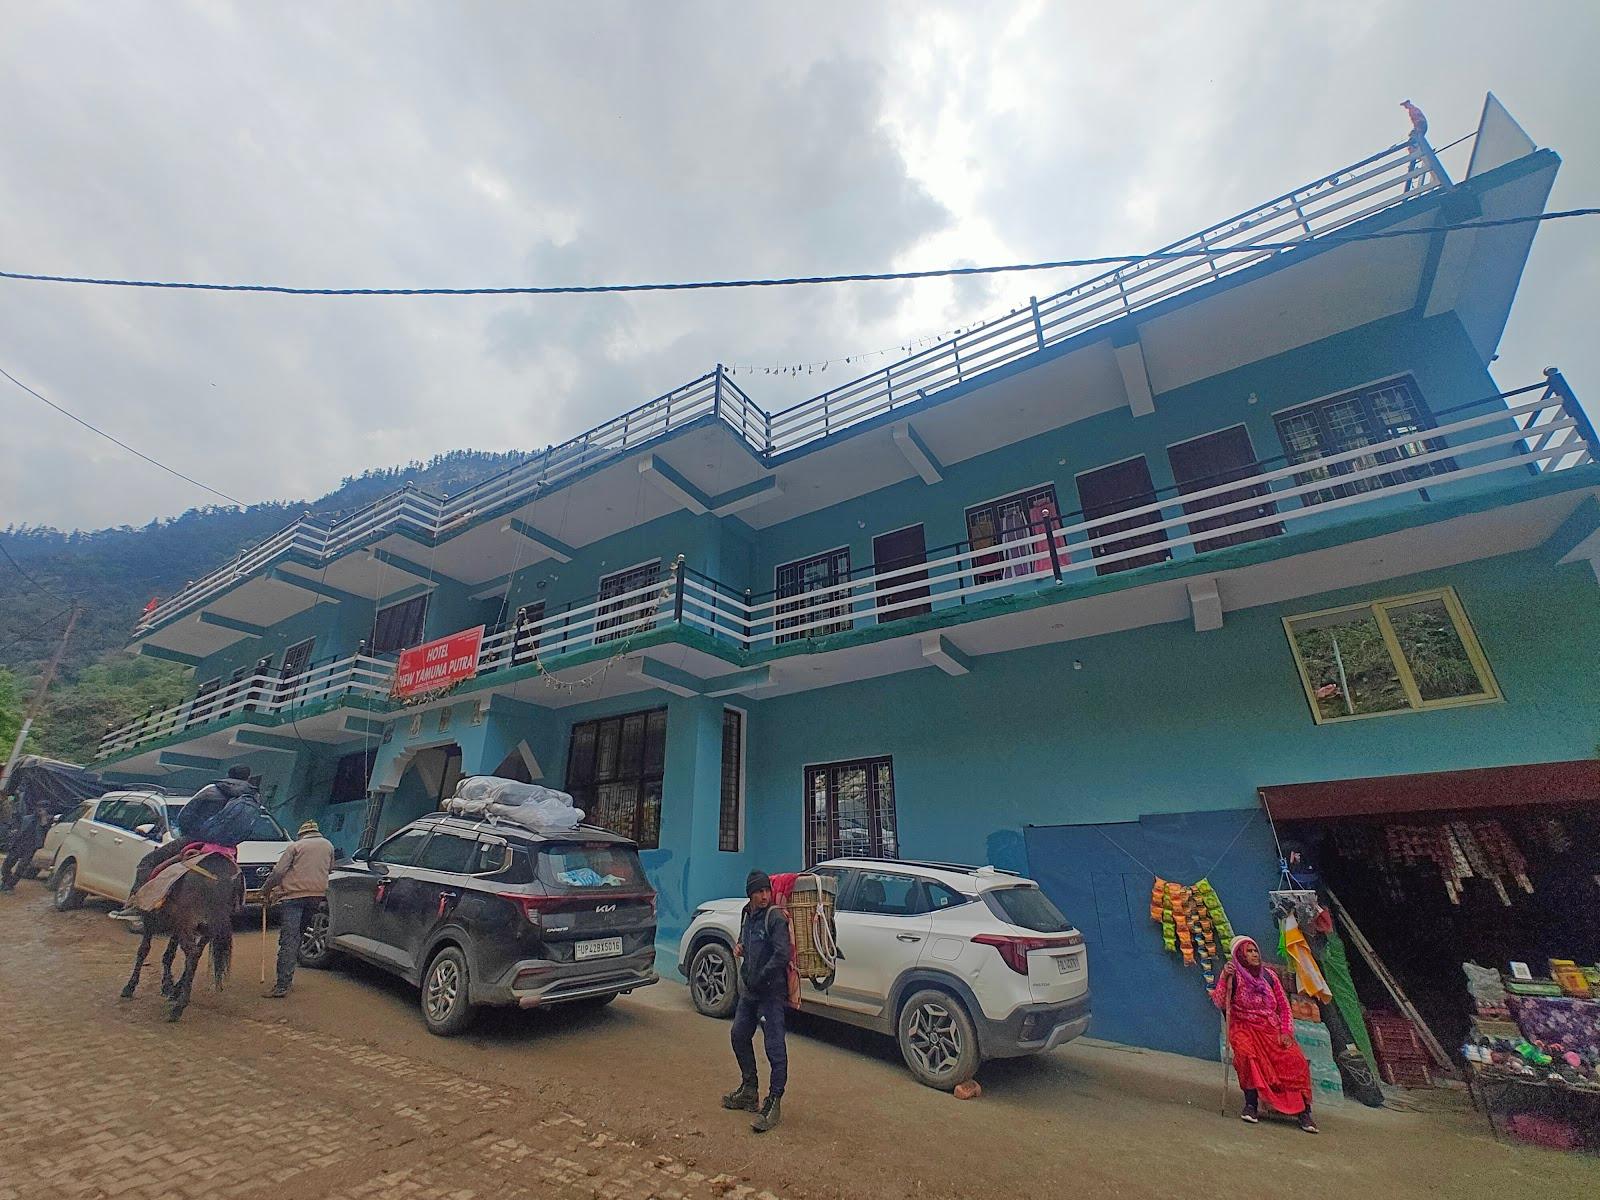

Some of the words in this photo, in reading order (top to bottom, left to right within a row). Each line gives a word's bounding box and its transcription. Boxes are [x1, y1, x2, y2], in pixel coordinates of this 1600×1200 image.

[426, 643, 449, 663] HOTEL
[399, 670, 416, 688] NEW
[415, 662, 447, 684] YAMUNA
[448, 654, 473, 674] PUTRA
